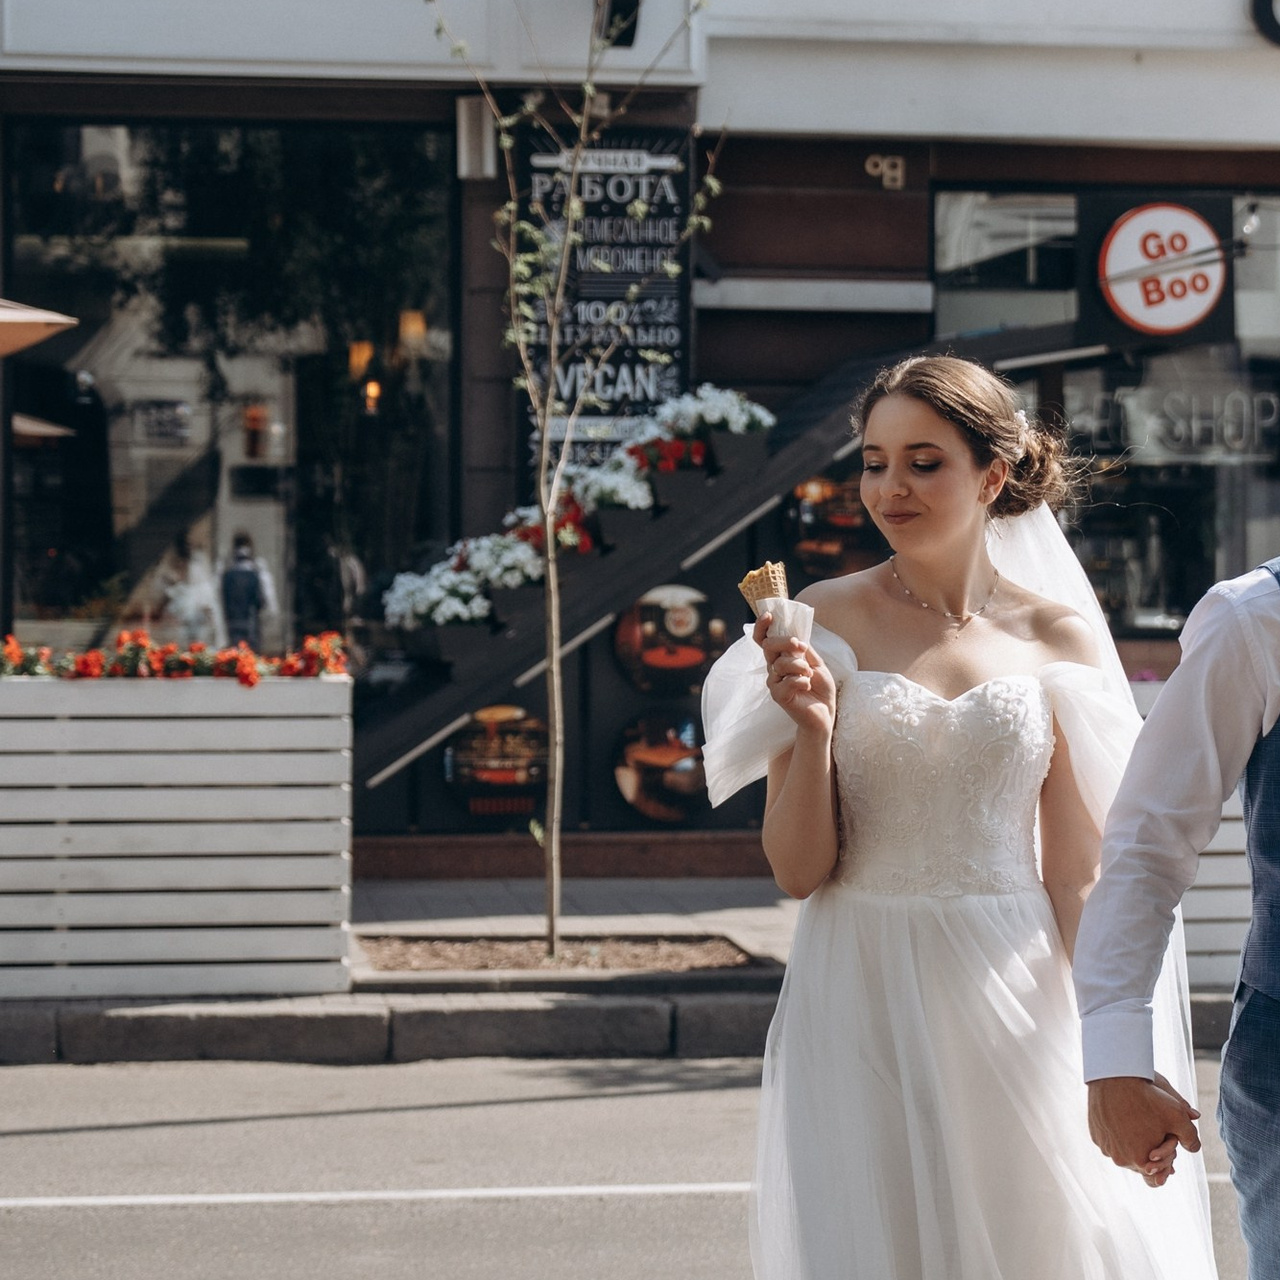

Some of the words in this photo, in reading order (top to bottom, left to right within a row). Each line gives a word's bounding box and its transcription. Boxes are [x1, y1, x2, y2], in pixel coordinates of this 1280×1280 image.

[531, 173, 680, 204] РАБОТА
[1141, 231, 1188, 260] Go
[1141, 272, 1209, 307] Boo
